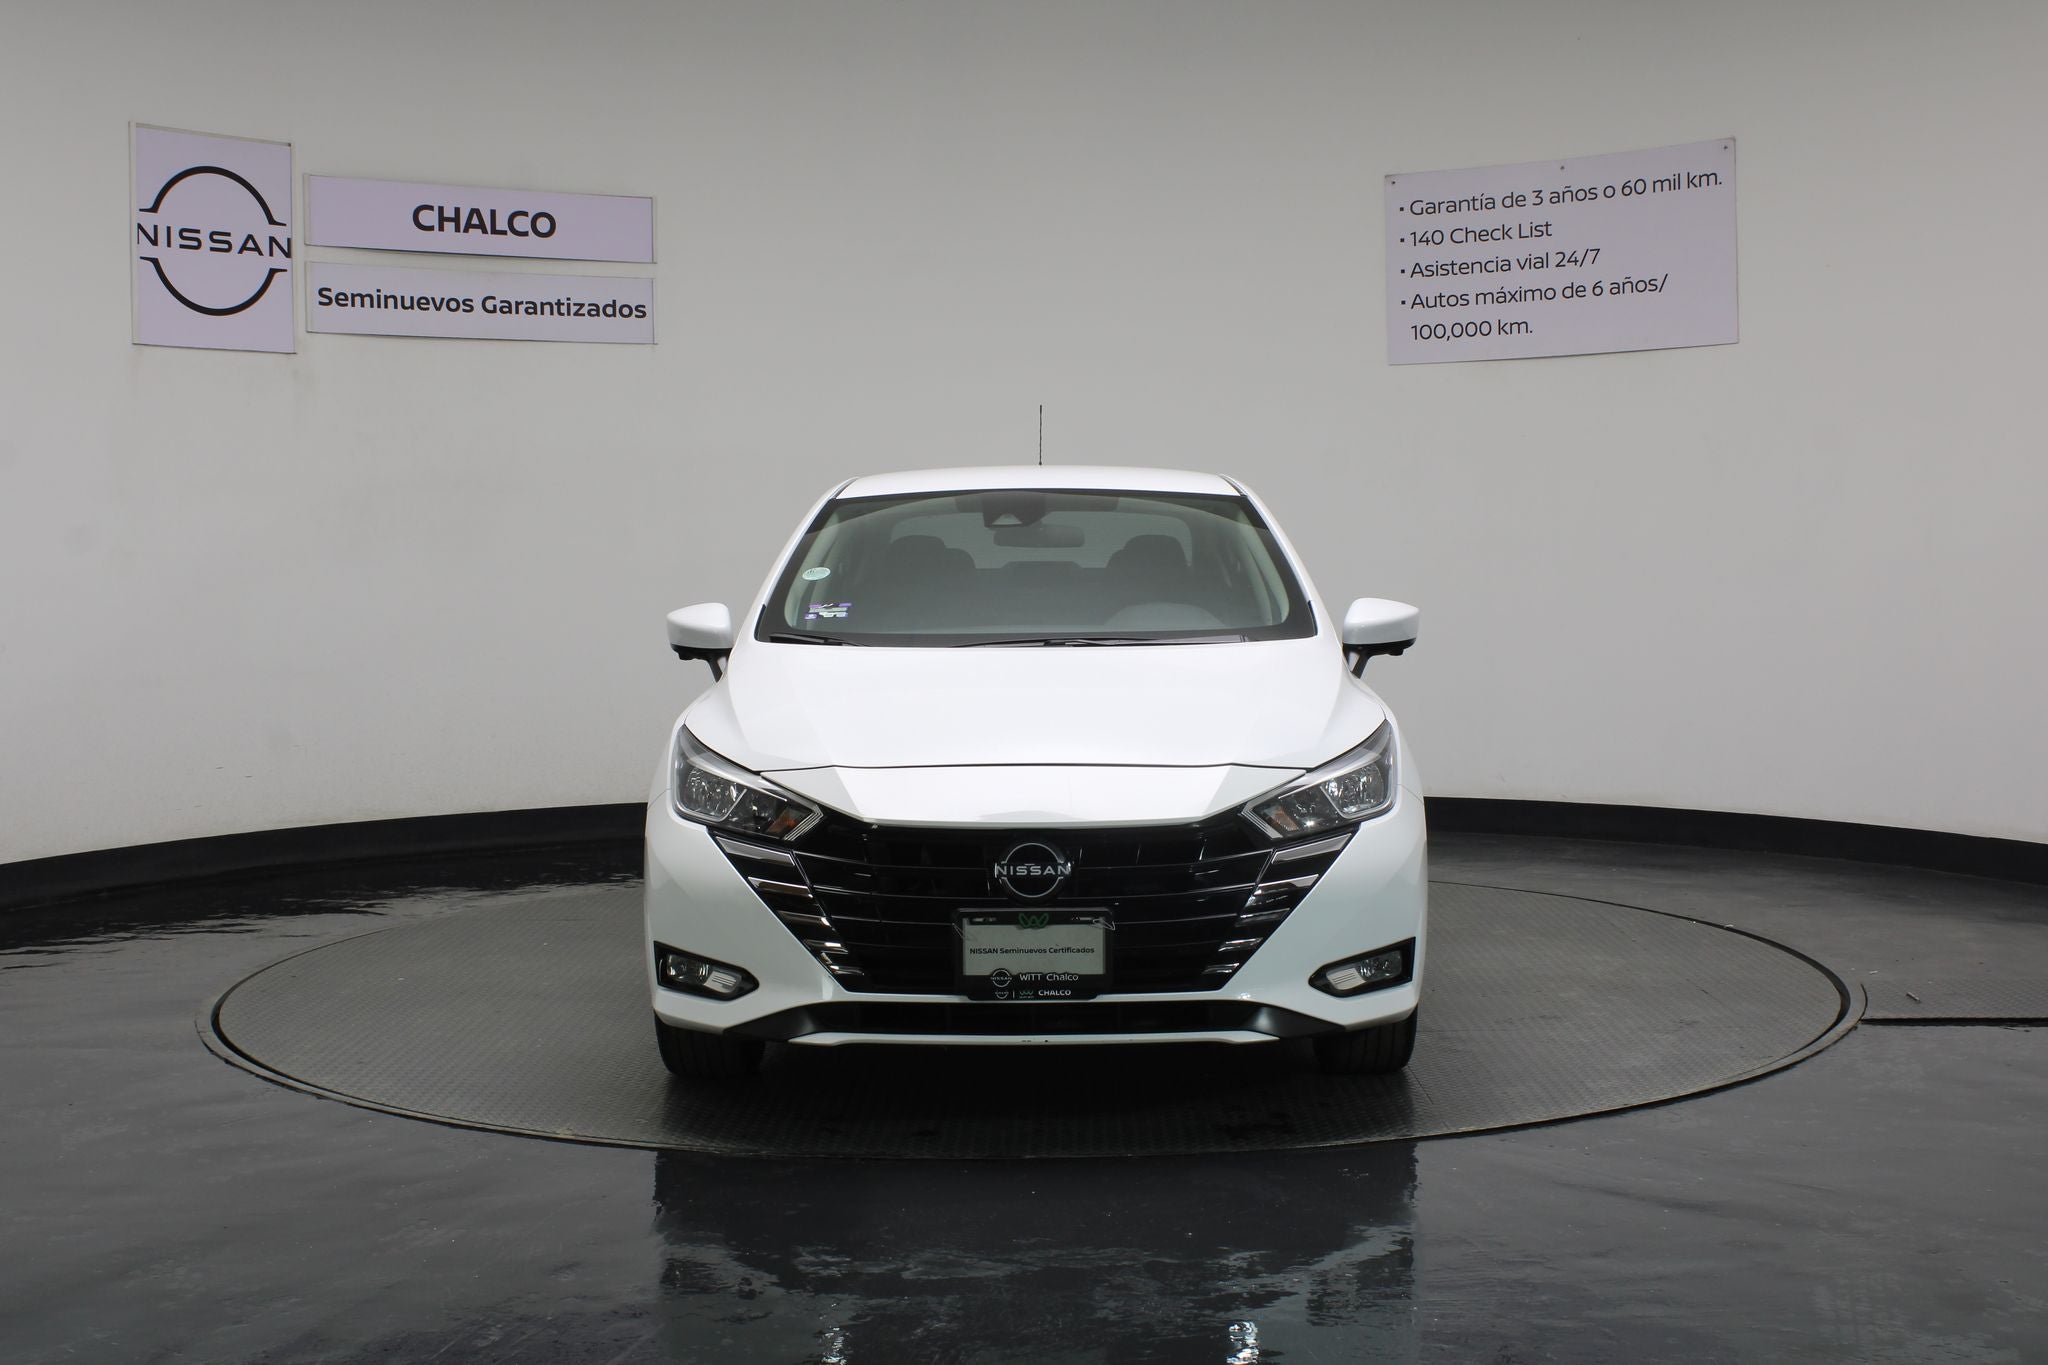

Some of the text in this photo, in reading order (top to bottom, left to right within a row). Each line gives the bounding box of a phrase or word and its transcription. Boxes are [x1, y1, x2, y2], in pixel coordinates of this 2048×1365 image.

[1410, 170, 1723, 216] Garantía de 3 años o 60 mil km.
[411, 204, 557, 239] CHALCO
[1410, 220, 1552, 246] 140 Check List
[137, 223, 292, 258] NISSAN
[1410, 248, 1601, 278] Asistencia vial 24/7
[317, 287, 647, 320] Seminuevos Garantizados
[1410, 273, 1668, 309] Autos máximo de 6 años/
[1411, 318, 1533, 342] 100,000 km.
[995, 865, 1070, 876] NISSAN
[1048, 946, 1095, 954] Certificados
[1019, 972, 1079, 981] WITT Chalco
